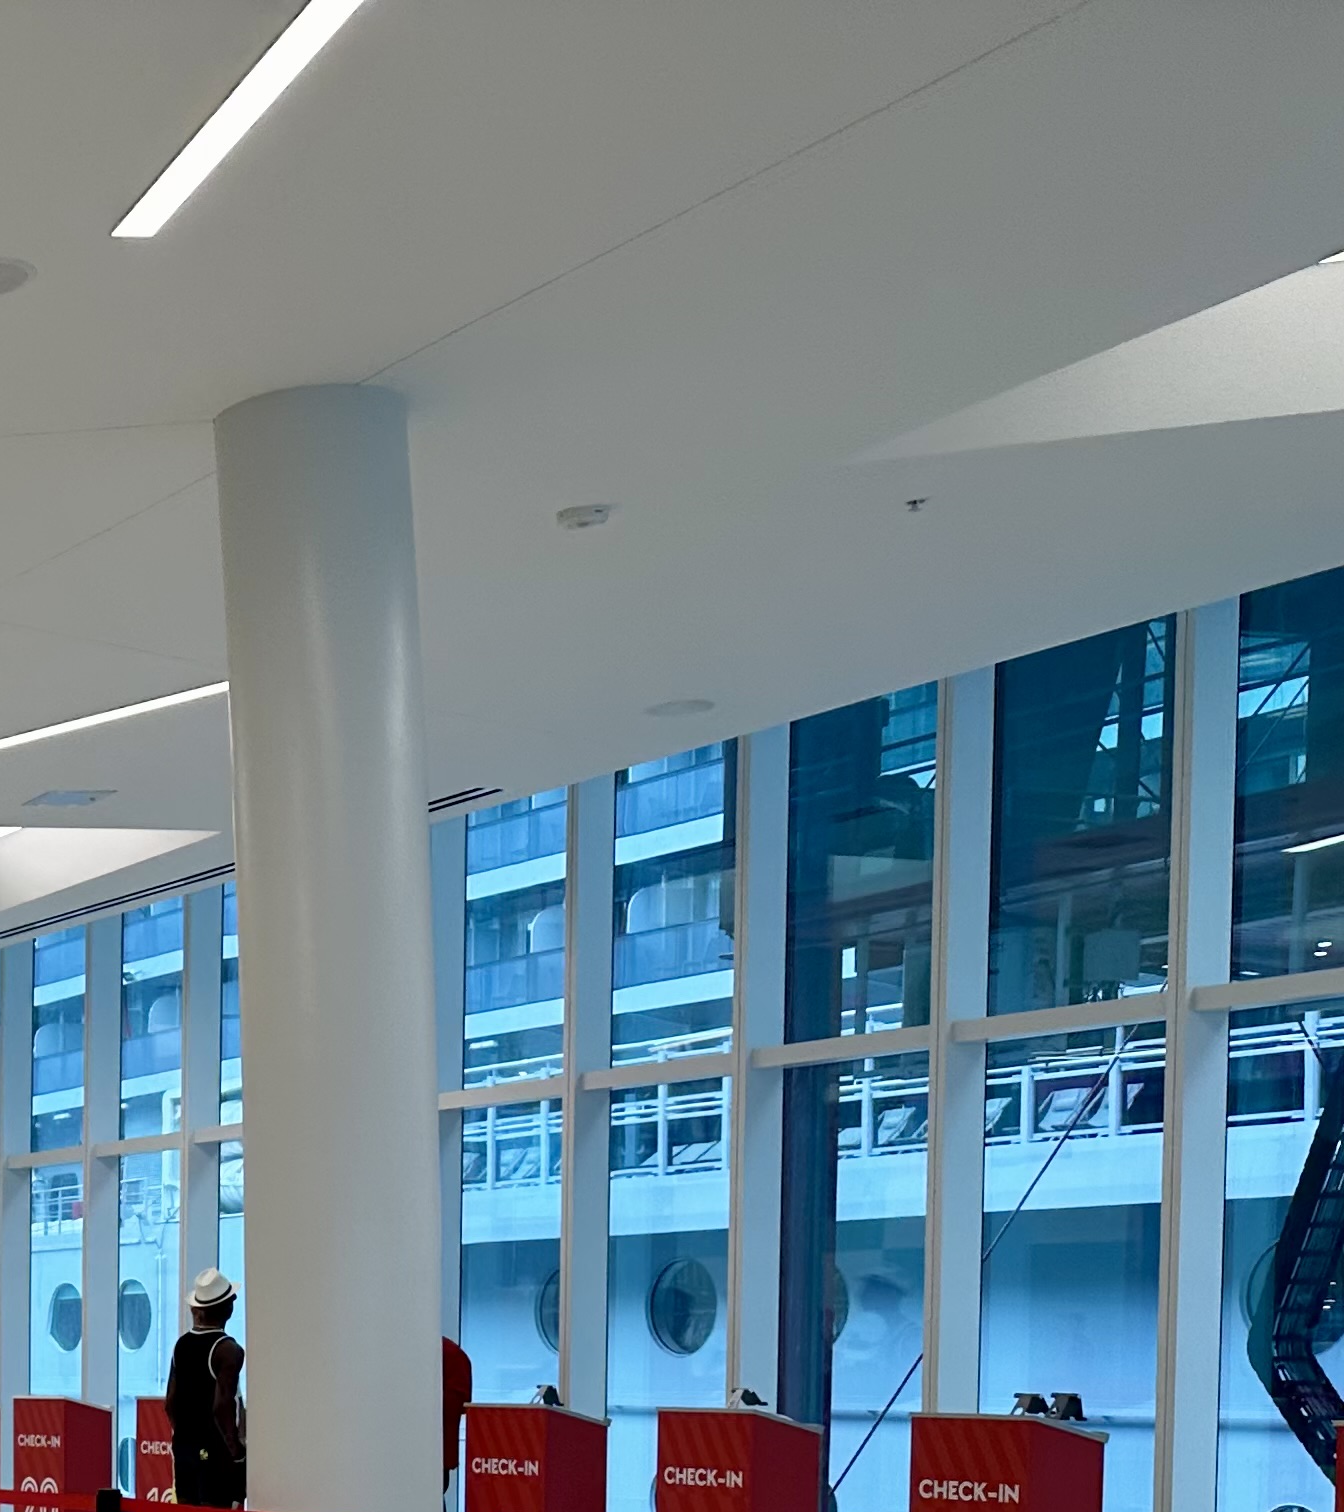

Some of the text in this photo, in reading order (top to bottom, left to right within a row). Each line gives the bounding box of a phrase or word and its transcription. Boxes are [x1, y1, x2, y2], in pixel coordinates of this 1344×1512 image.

[17, 1434, 61, 1448] CHECK-IN
[140, 1440, 173, 1454] CHECK
[471, 1457, 539, 1476] CHECK-IN
[663, 1466, 743, 1488] CHECK-IN
[918, 1479, 1020, 1504] CHECK-IN
